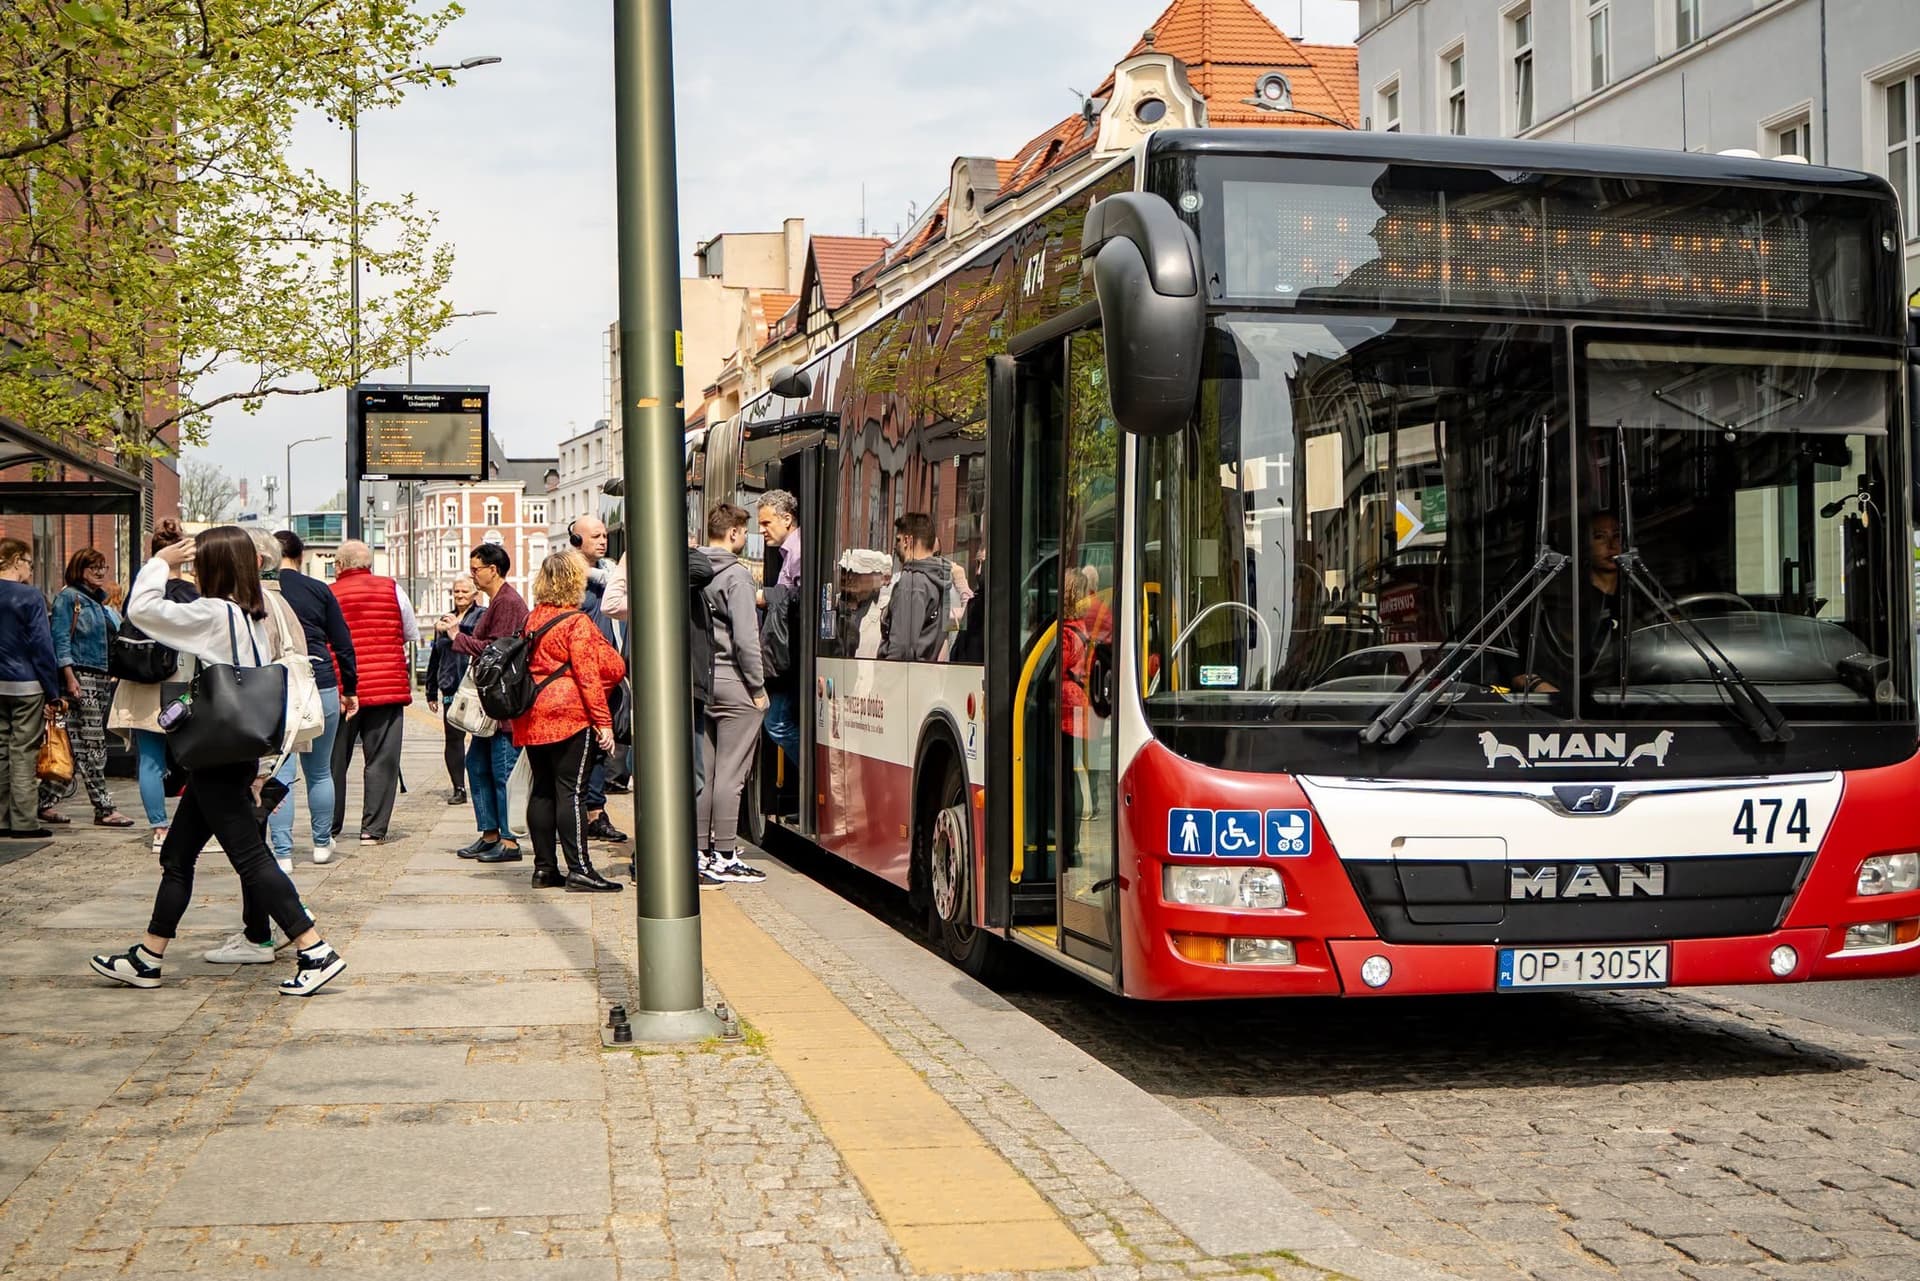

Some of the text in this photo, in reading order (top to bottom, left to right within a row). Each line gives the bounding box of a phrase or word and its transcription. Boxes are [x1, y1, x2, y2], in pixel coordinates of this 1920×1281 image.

[1023, 249, 1046, 297] 474
[1528, 733, 1626, 759] MAN
[1733, 798, 1810, 844] 474
[1510, 863, 1665, 899] MAN
[1501, 972, 1512, 980] PL
[1519, 949, 1661, 982] OP 1305K
